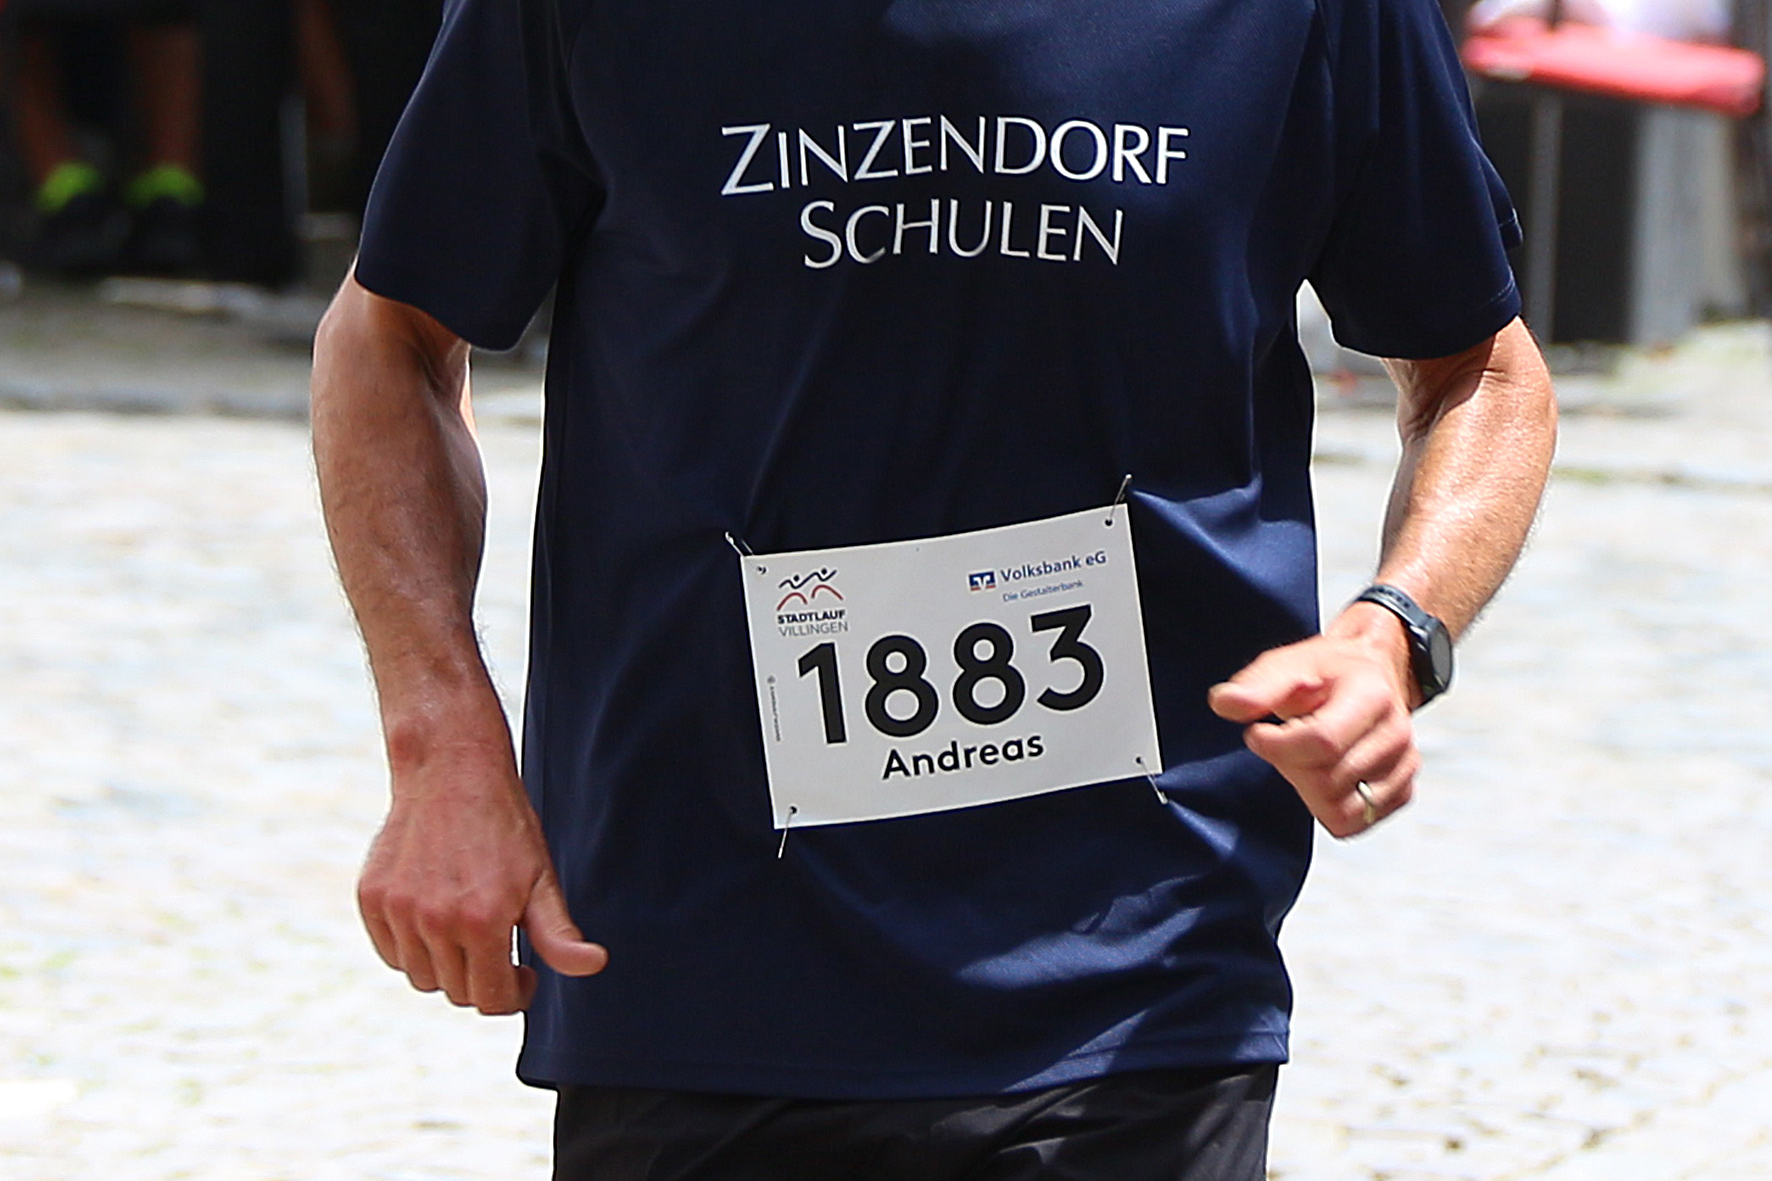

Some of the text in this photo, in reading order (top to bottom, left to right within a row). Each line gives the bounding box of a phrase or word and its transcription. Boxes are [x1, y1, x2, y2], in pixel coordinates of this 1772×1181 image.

[721, 115, 1189, 196] ZINZENDORF
[800, 198, 1124, 269] SCHULEN
[1001, 550, 1106, 582] Volksbank eG
[1002, 579, 1084, 602] Die Gestalterbank
[777, 609, 846, 625] STADTLAUF
[778, 621, 849, 637] VILLINGEN
[797, 604, 1104, 745] 1883
[882, 733, 1045, 780] Andreas
